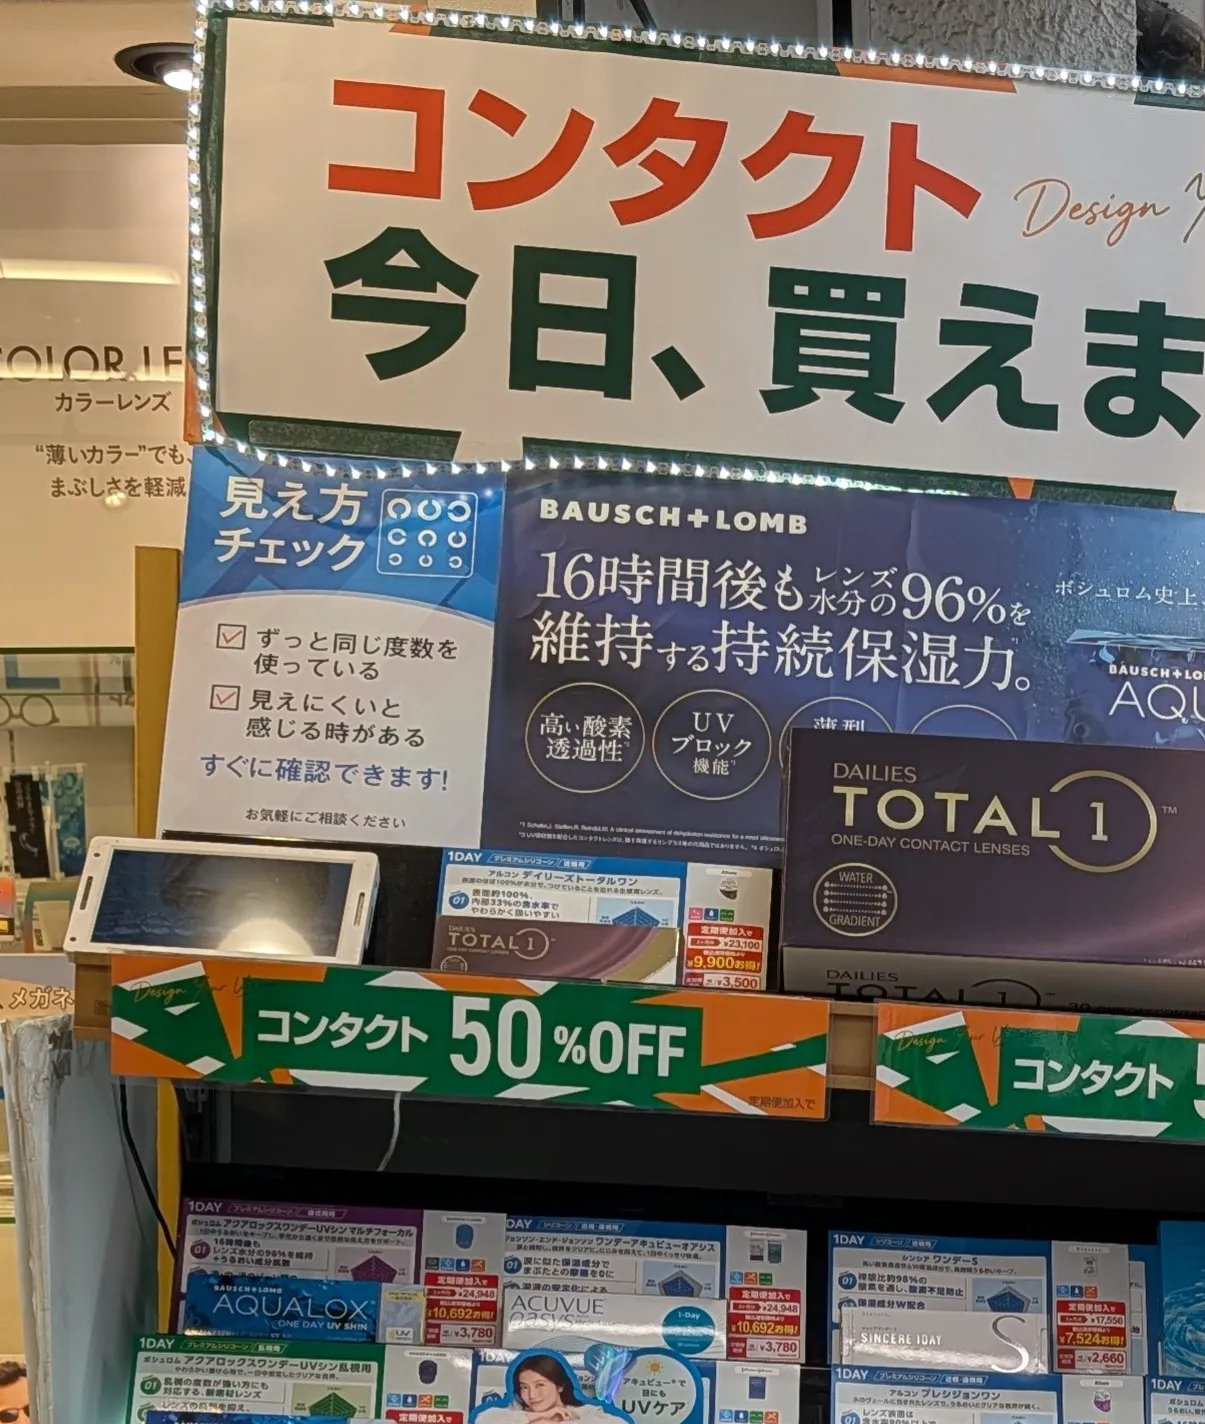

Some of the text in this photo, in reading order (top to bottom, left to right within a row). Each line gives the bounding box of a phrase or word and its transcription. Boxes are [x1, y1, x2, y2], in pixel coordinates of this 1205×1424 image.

[329, 79, 981, 252] コンタクト
[1016, 177, 1170, 246] Design
[0, 346, 126, 382] OLOR
[55, 392, 171, 412] カラーレンズ
[52, 477, 186, 497] まぶしさを軽減
[219, 476, 368, 524] 見え方
[539, 498, 807, 535] BAUSCH+LOMB
[214, 527, 367, 573] チェック
[535, 551, 804, 613] 16時間後も
[808, 588, 897, 618] 水分の
[257, 627, 459, 661] ずっと同じ度数を
[254, 654, 380, 680] 使っている
[249, 689, 401, 719] 見えにくいと
[246, 716, 426, 748] 感じる時がある
[540, 713, 632, 739] 高い酸素
[545, 738, 624, 763] 透過性
[671, 734, 752, 757] ブロック
[200, 753, 449, 792] すぐに確認できます!
[692, 758, 730, 776] 機能
[832, 762, 917, 784] DAILIES
[244, 808, 406, 829] お気軽にご相談ください
[832, 785, 1061, 839] TOTAL
[830, 833, 1030, 856] ONE-DAY CONTACT LENSES
[488, 869, 638, 887] アルコン デイリーズトータルワン
[838, 871, 873, 884] WATER
[828, 913, 881, 928] GRADIENT
[826, 968, 899, 983] DAILIES
[9, 985, 75, 1010] メガネ
[257, 1008, 429, 1053] コンタクト
[1013, 1057, 1175, 1101] コンタクト
[213, 1293, 368, 1320] AQUALOX
[510, 1295, 604, 1315] ACUVUE
[139, 1338, 175, 1350] 1DAY
[861, 1332, 912, 1345] SINCERE
[921, 1389, 1001, 1400] プレシジョンワン
[621, 1400, 686, 1416] UVケア
